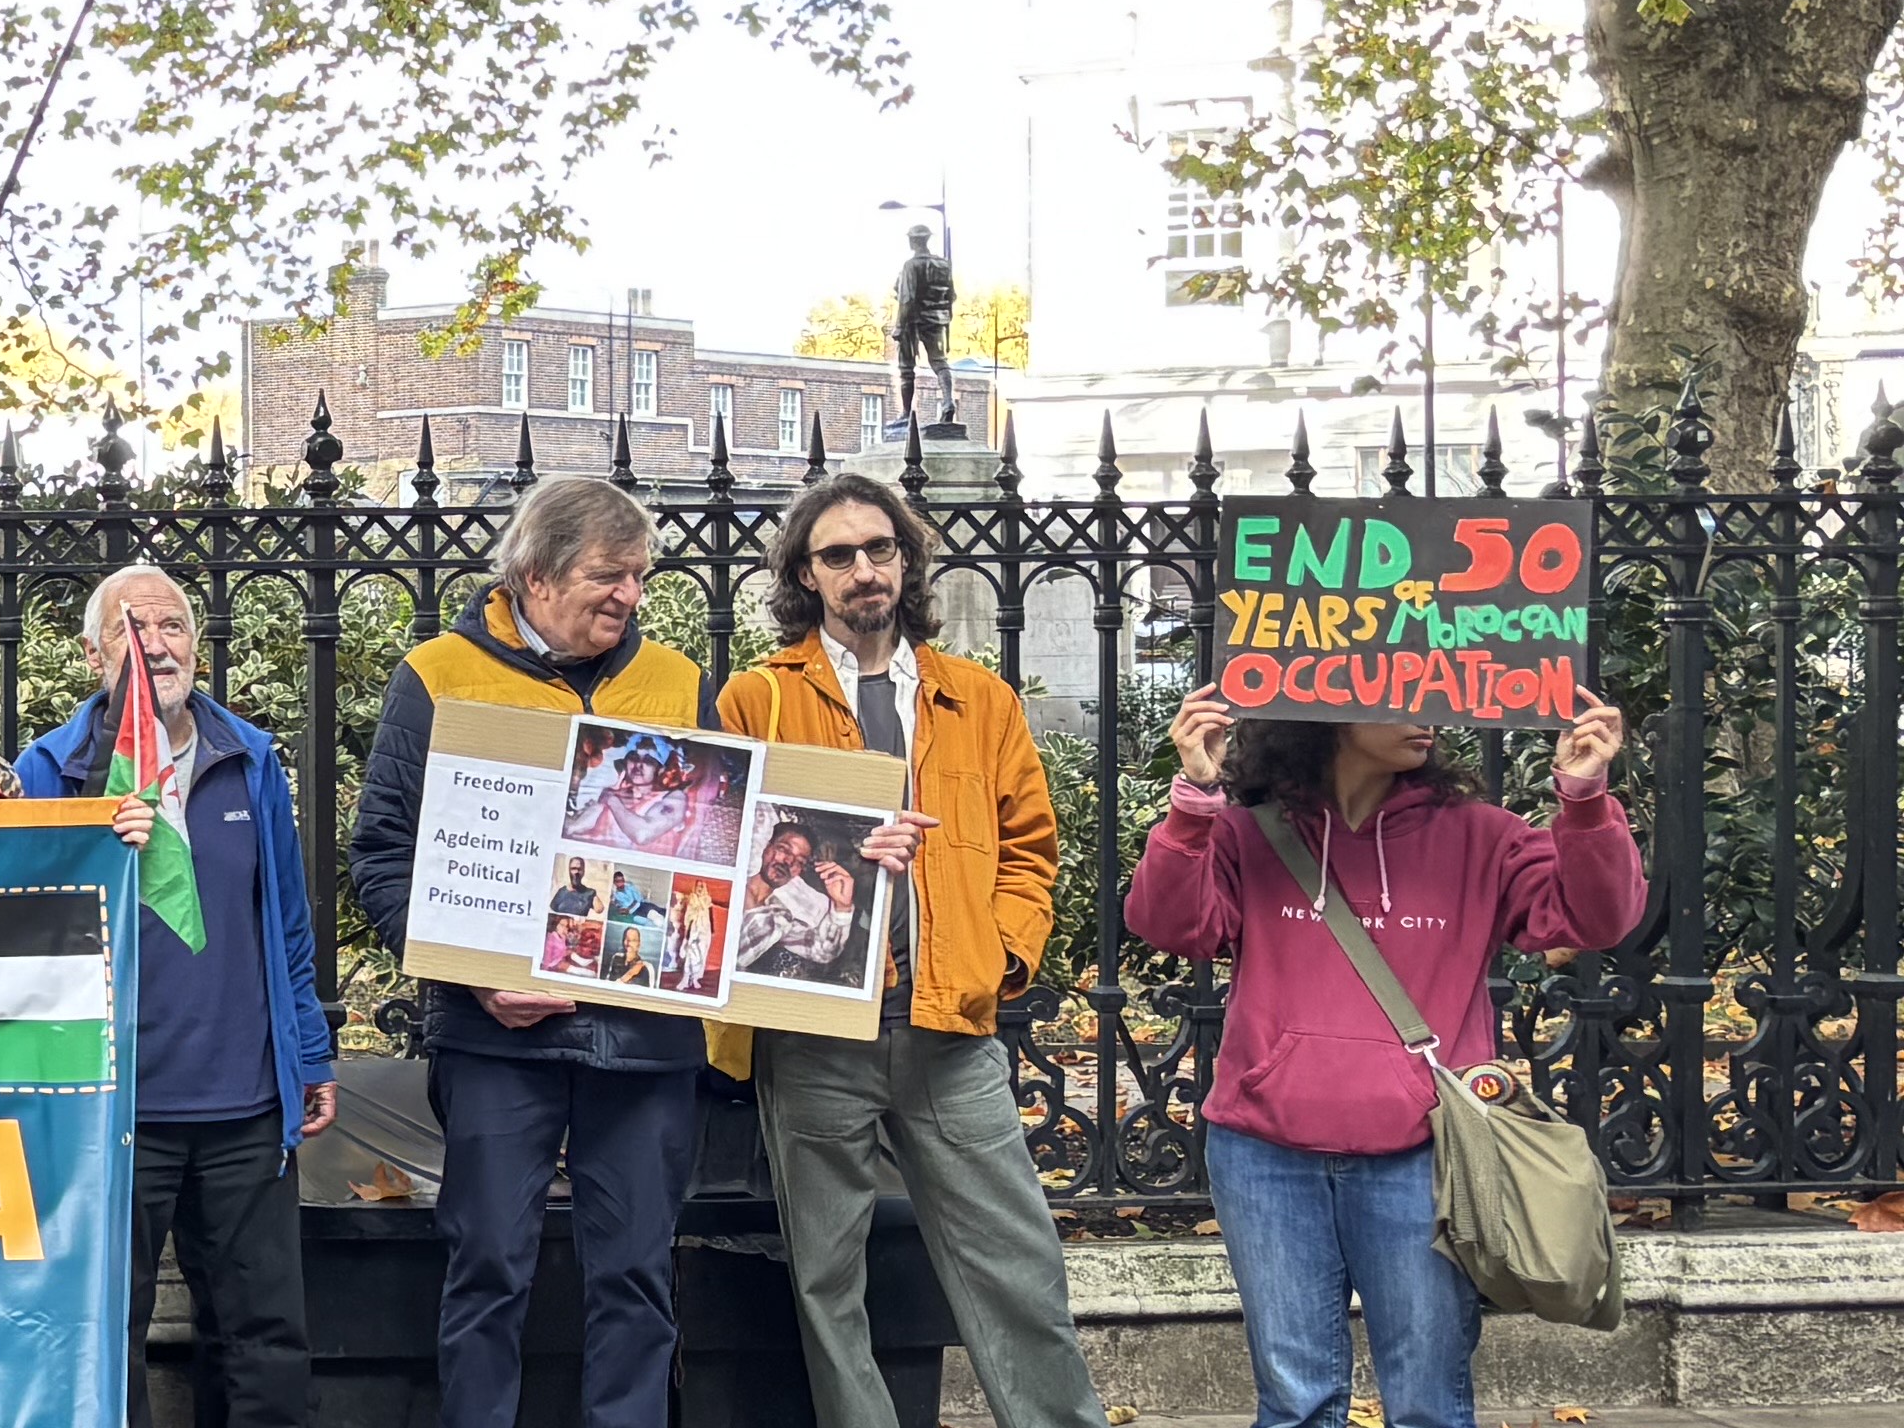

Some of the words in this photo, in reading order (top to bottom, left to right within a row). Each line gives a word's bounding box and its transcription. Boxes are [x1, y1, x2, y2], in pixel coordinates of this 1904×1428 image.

[1235, 517, 1412, 590] END
[1439, 518, 1582, 594] 50
[1394, 580, 1434, 610] OF
[1220, 589, 1387, 651] YEARS
[1386, 600, 1588, 649] MOROCCAN
[1220, 650, 1575, 720] OCCUPATION
[453, 771, 534, 797] Freedom
[480, 805, 500, 821] to
[433, 828, 504, 853] Agdeim
[447, 859, 520, 885] Political
[428, 886, 532, 917] Prisonners!
[1357, 916, 1385, 929] RK
[1400, 916, 1447, 930] CITY
